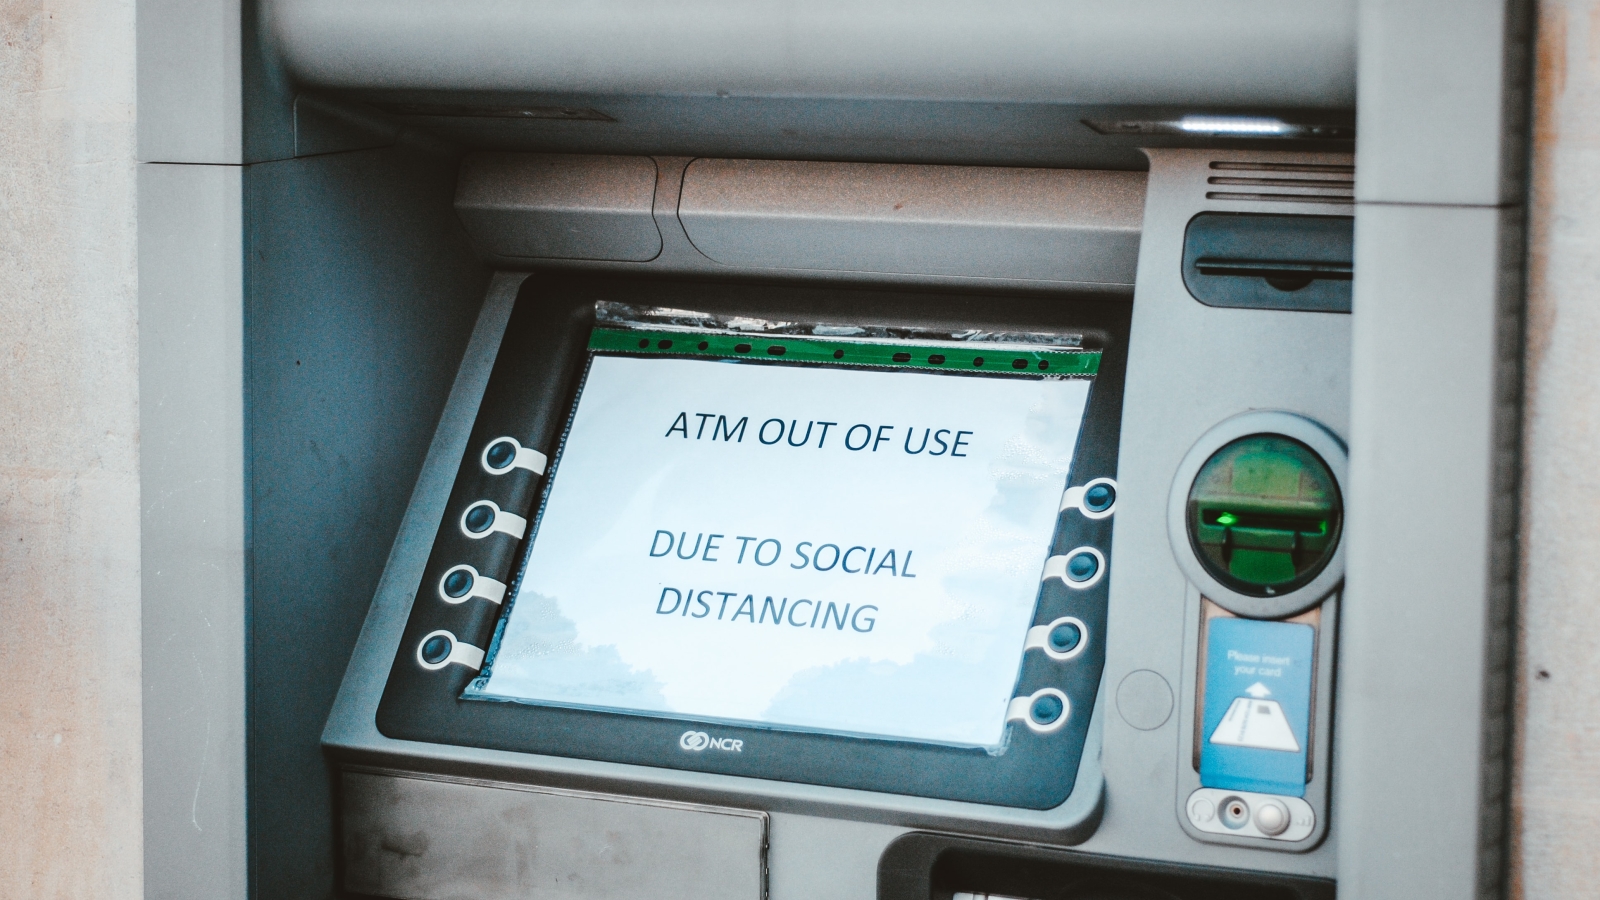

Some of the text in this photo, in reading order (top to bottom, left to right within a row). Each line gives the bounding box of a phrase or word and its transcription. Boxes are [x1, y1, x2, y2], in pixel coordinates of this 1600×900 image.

[665, 411, 974, 457] ATM OUT OF USE
[649, 529, 917, 578] DUE TO SOCIAL
[655, 587, 879, 633] DISTANCING
[1227, 650, 1291, 666] Please insert
[1233, 665, 1282, 677] your card
[709, 737, 744, 752] NCR
